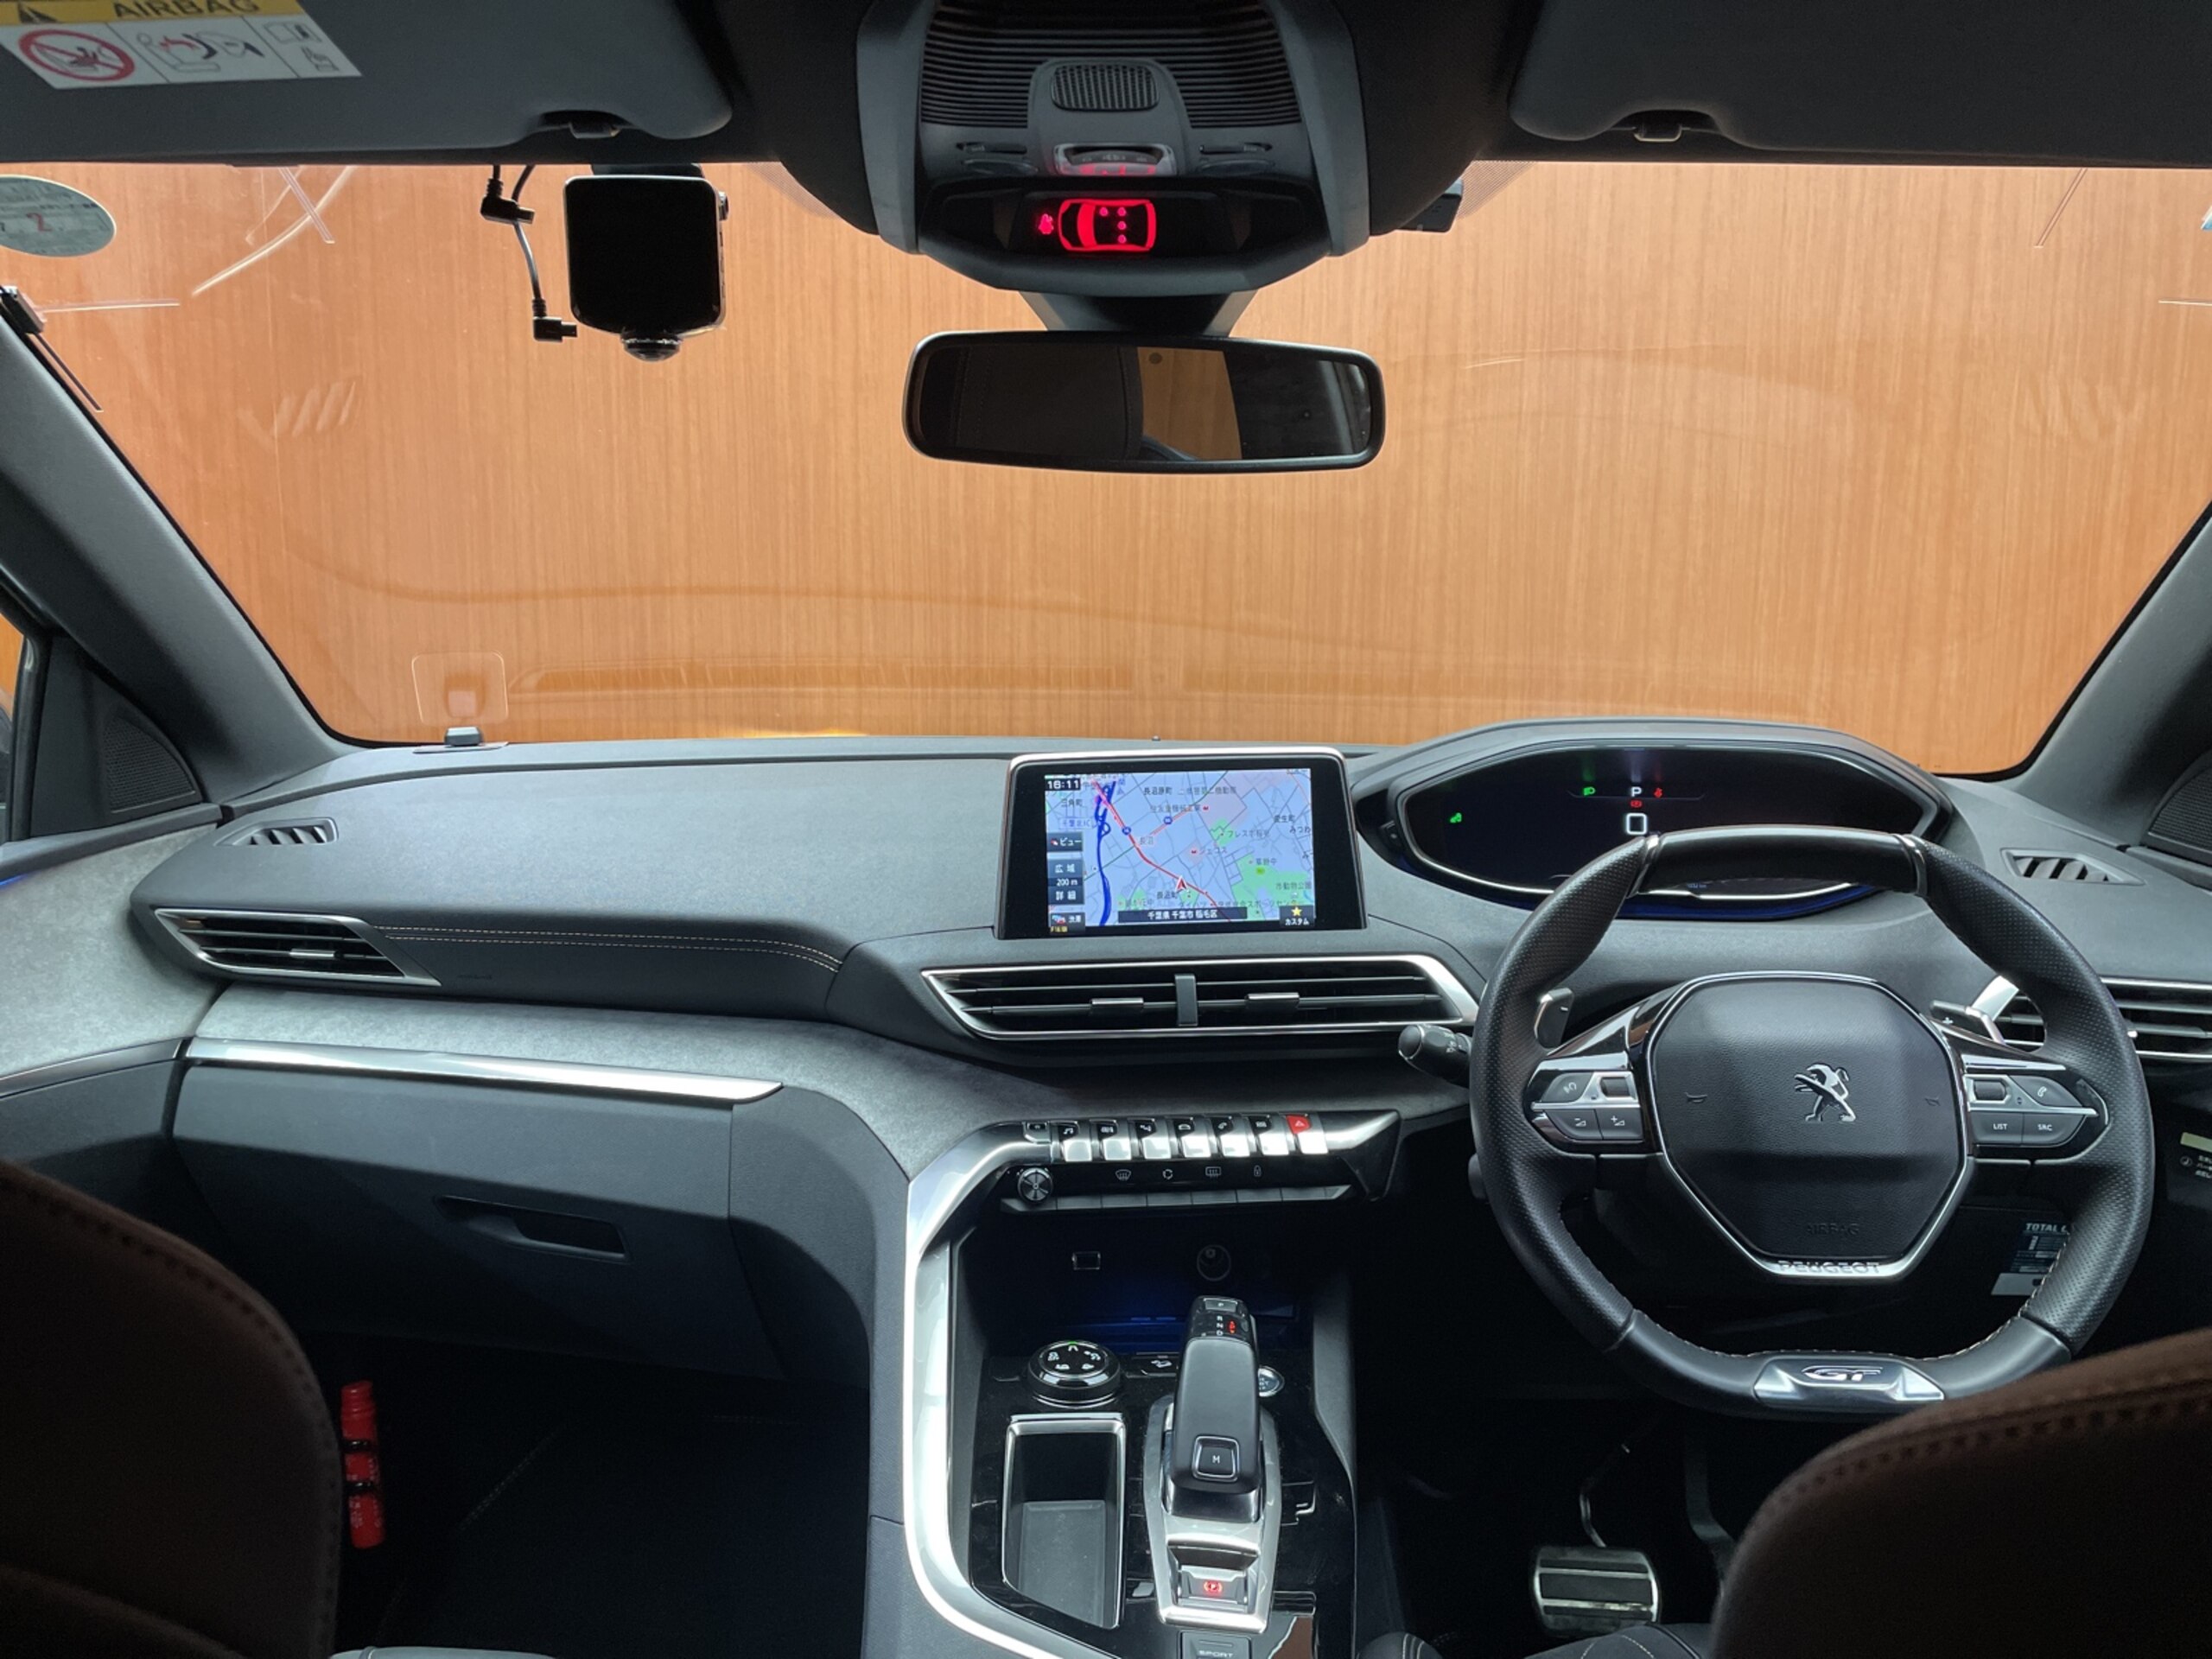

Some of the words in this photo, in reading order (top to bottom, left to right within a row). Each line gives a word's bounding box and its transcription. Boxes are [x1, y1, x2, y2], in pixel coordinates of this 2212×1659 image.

[112, 0, 260, 18] AIRBAG
[1630, 787, 1643, 797] P
[1626, 812, 1647, 835] 0
[1059, 836, 1082, 847] ビュー
[1056, 878, 1070, 887] 200
[2026, 1223, 2057, 1232] TOTAL
[1212, 1455, 1220, 1464] M
[1198, 1649, 1234, 1658] SPORT
